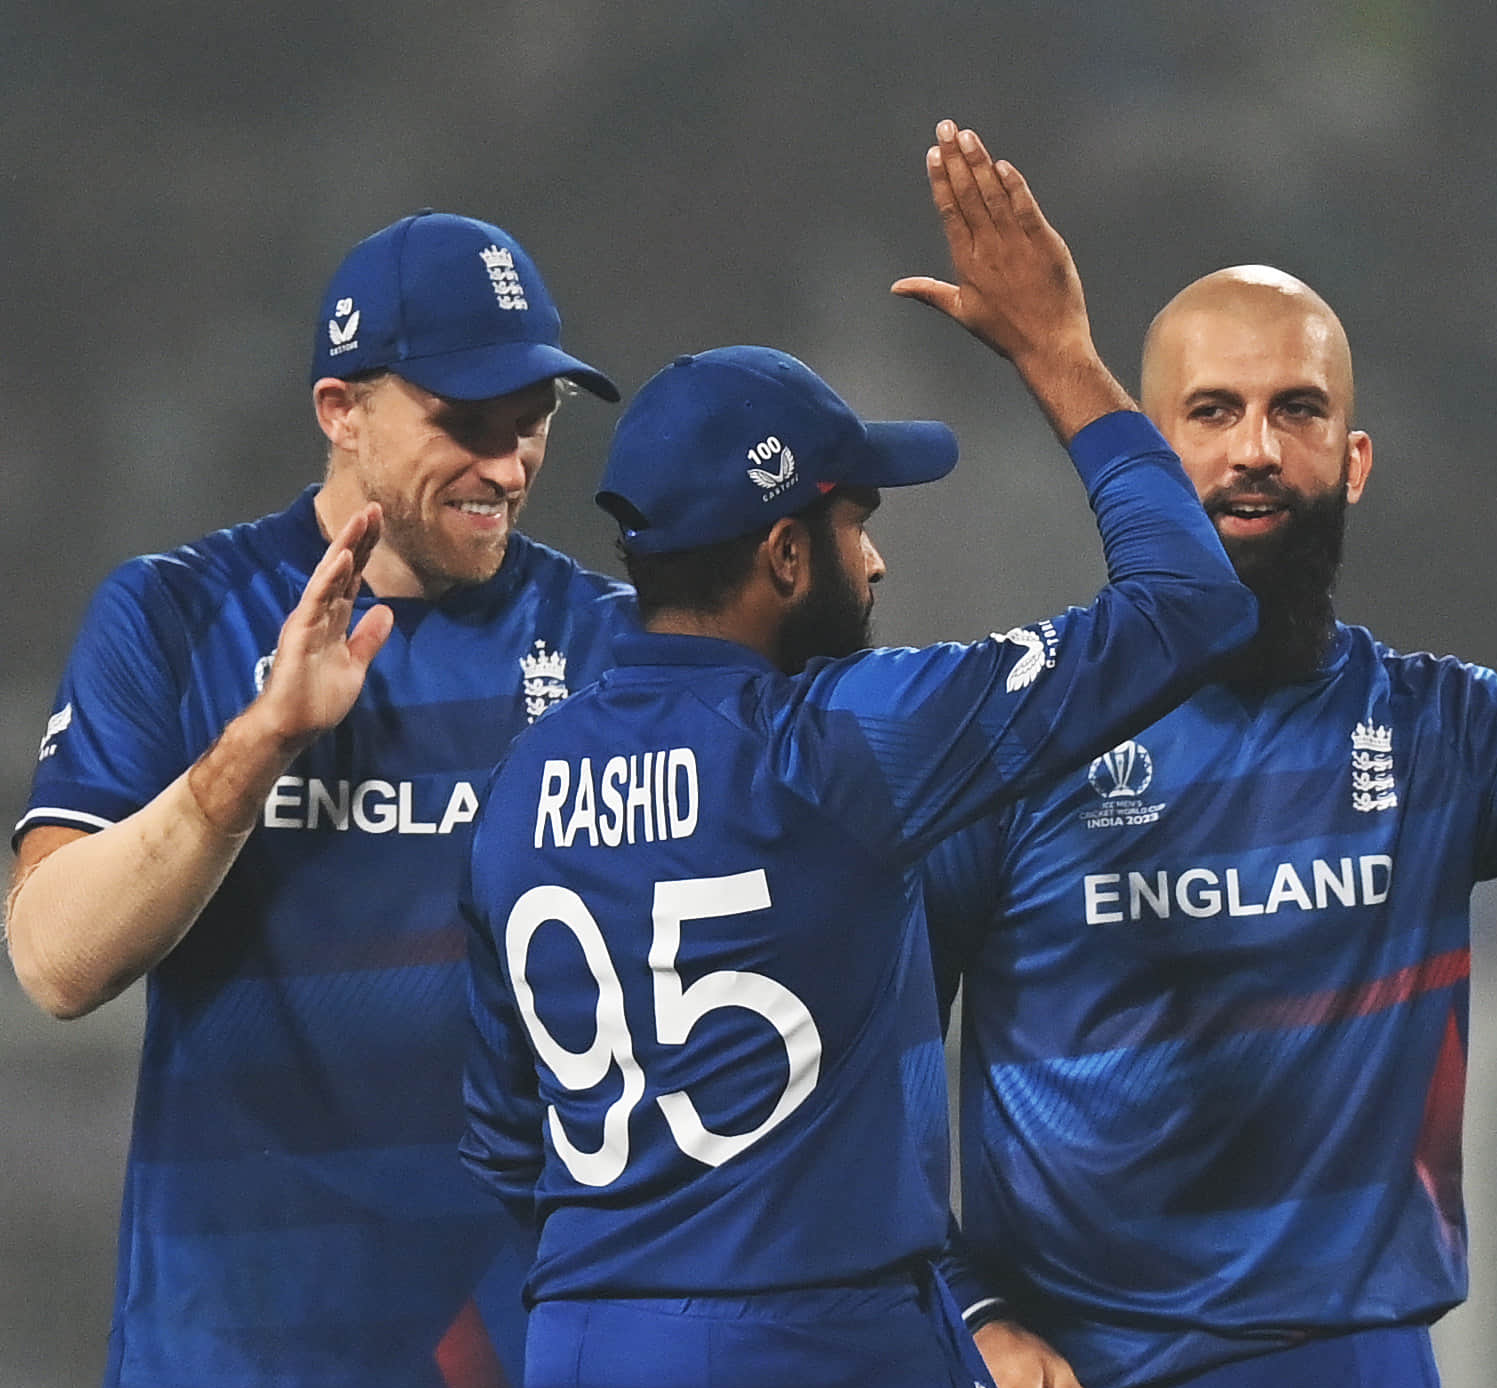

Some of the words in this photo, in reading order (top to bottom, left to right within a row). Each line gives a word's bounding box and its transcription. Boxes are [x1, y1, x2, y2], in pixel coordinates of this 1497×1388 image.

[335, 297, 353, 318] 50
[747, 436, 782, 465] 100
[534, 747, 699, 849] RASHID
[1087, 816, 1124, 829] INDIA
[1083, 854, 1394, 926] ENGLAND
[504, 868, 823, 1188] 95
